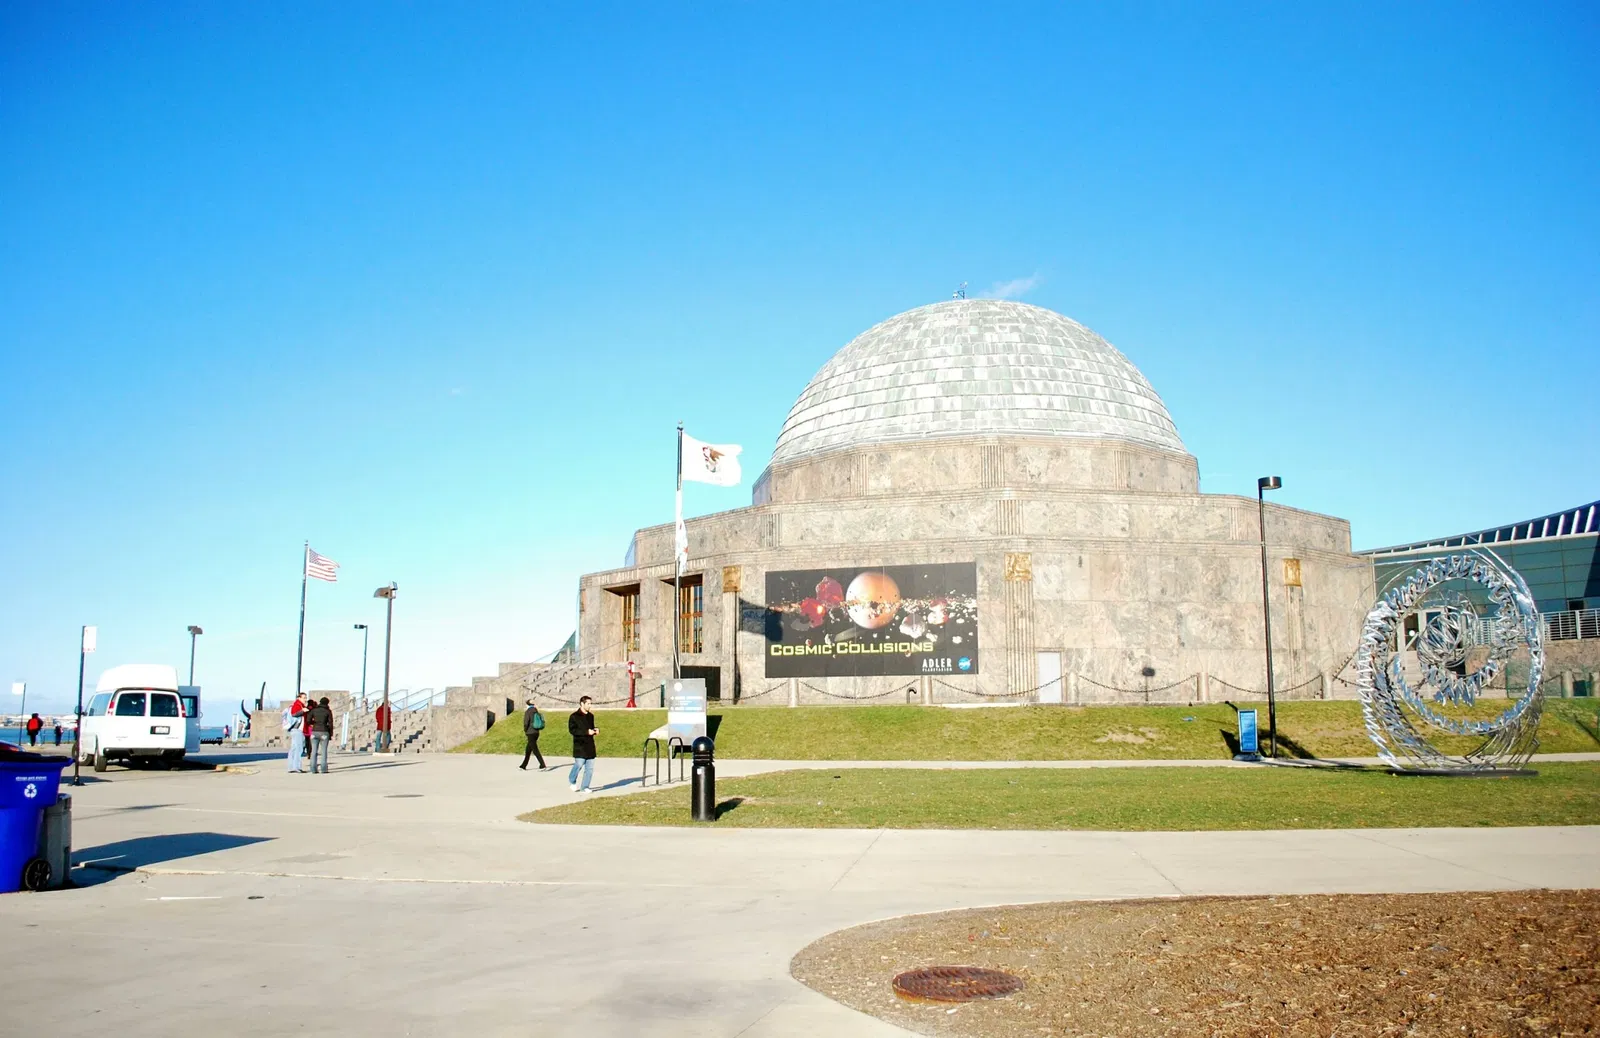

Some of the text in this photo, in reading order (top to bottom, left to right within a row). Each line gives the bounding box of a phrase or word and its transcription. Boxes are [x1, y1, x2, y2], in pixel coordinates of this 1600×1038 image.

[770, 641, 934, 656] COSMIC COLLISIONS
[922, 658, 952, 668] ADLER
